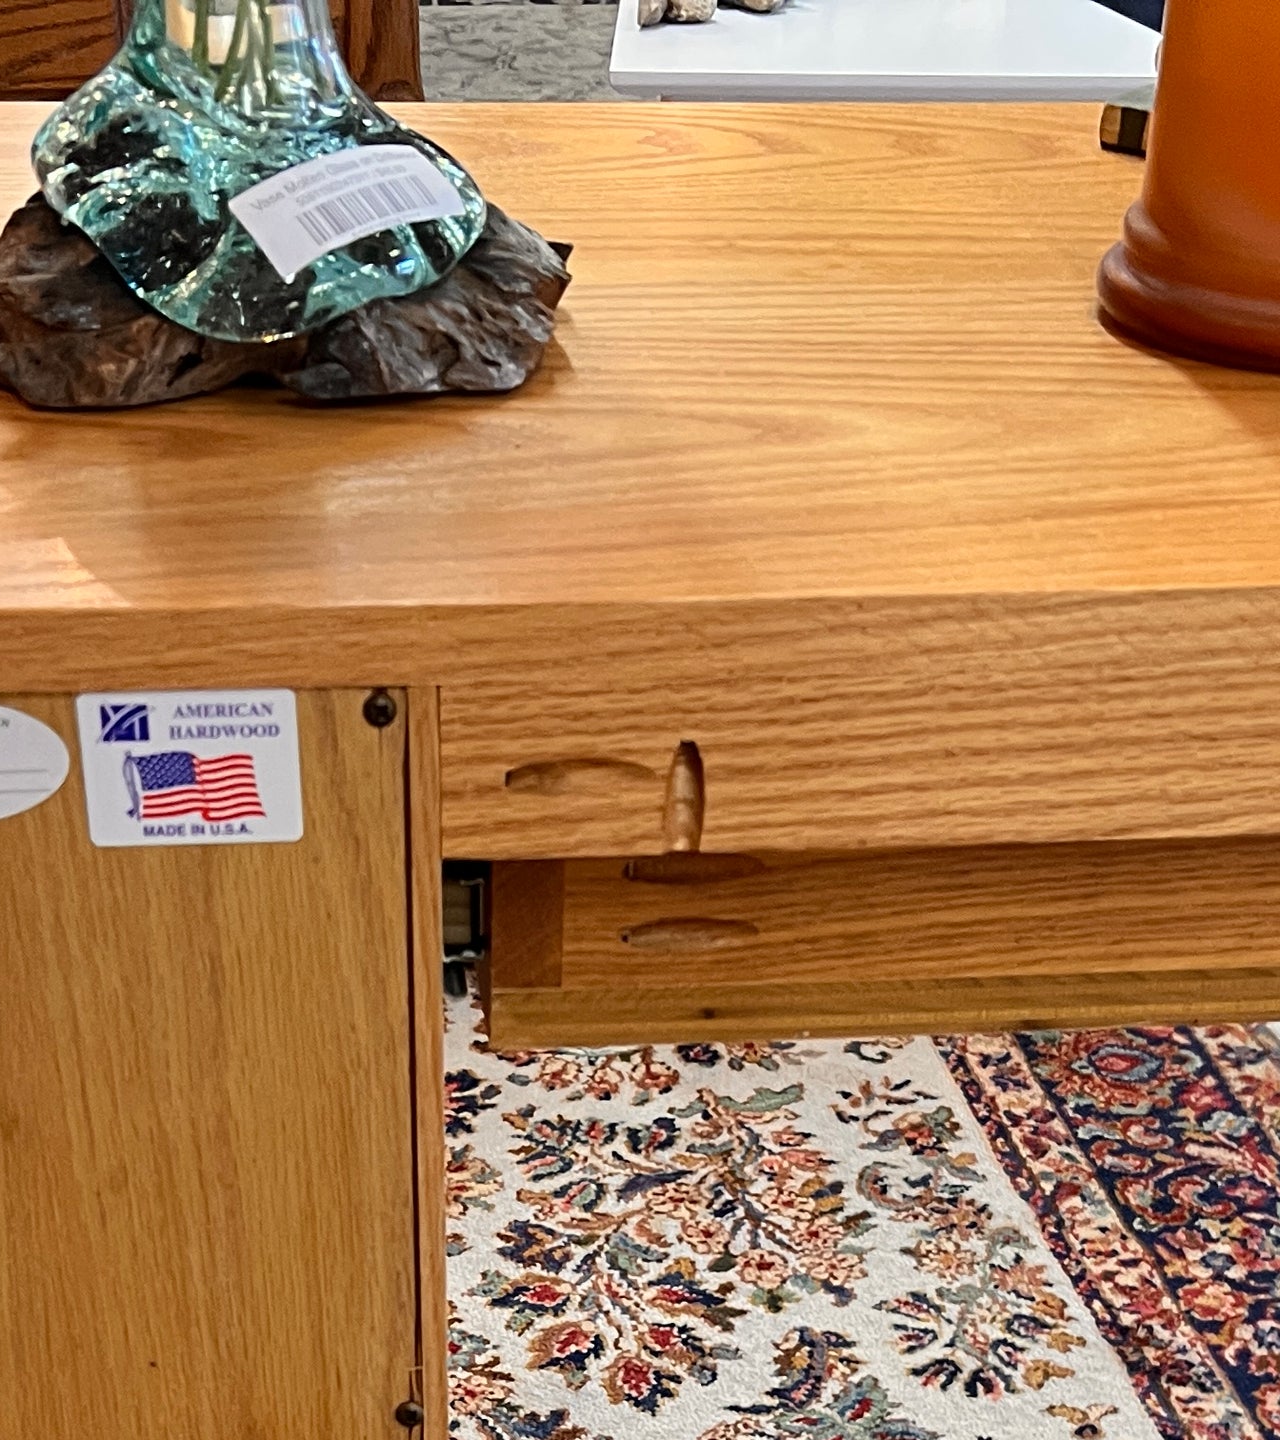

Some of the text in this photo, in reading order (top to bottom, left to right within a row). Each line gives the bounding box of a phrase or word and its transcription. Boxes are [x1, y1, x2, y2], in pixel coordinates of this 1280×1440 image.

[249, 191, 285, 211] Vase
[173, 703, 275, 718] AMERICAN
[169, 724, 281, 740] HARDWOOD
[143, 823, 253, 837] MADE IN U.S.A.
